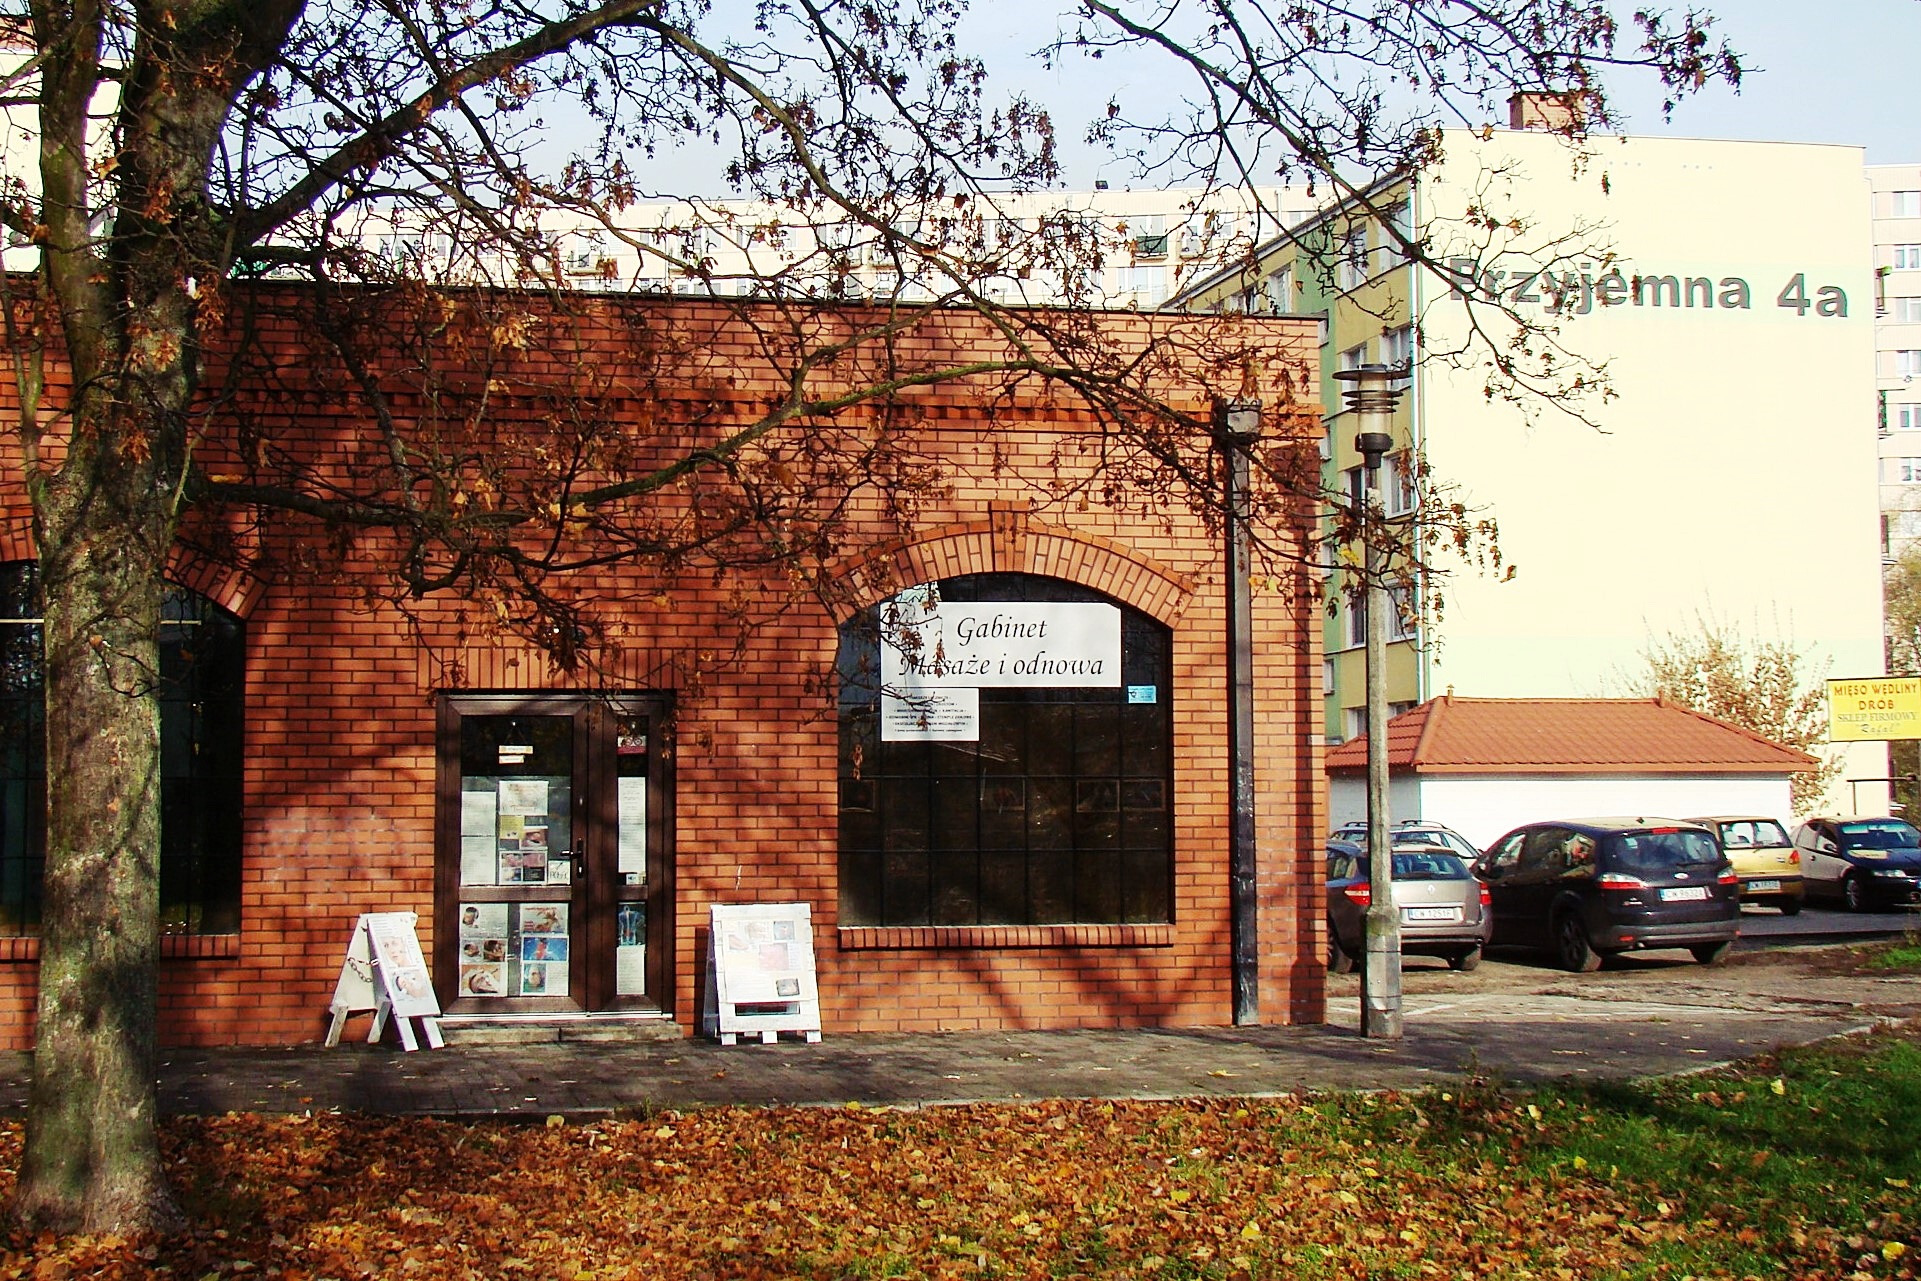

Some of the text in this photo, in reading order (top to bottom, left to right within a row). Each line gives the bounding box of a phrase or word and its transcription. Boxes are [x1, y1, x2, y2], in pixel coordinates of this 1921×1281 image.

[1450, 258, 1848, 317] Przyjemna 4a
[957, 614, 1048, 646] Gabinet
[898, 650, 1103, 676] Masaże i odnowa
[1869, 711, 1917, 721] FIRMOWY
